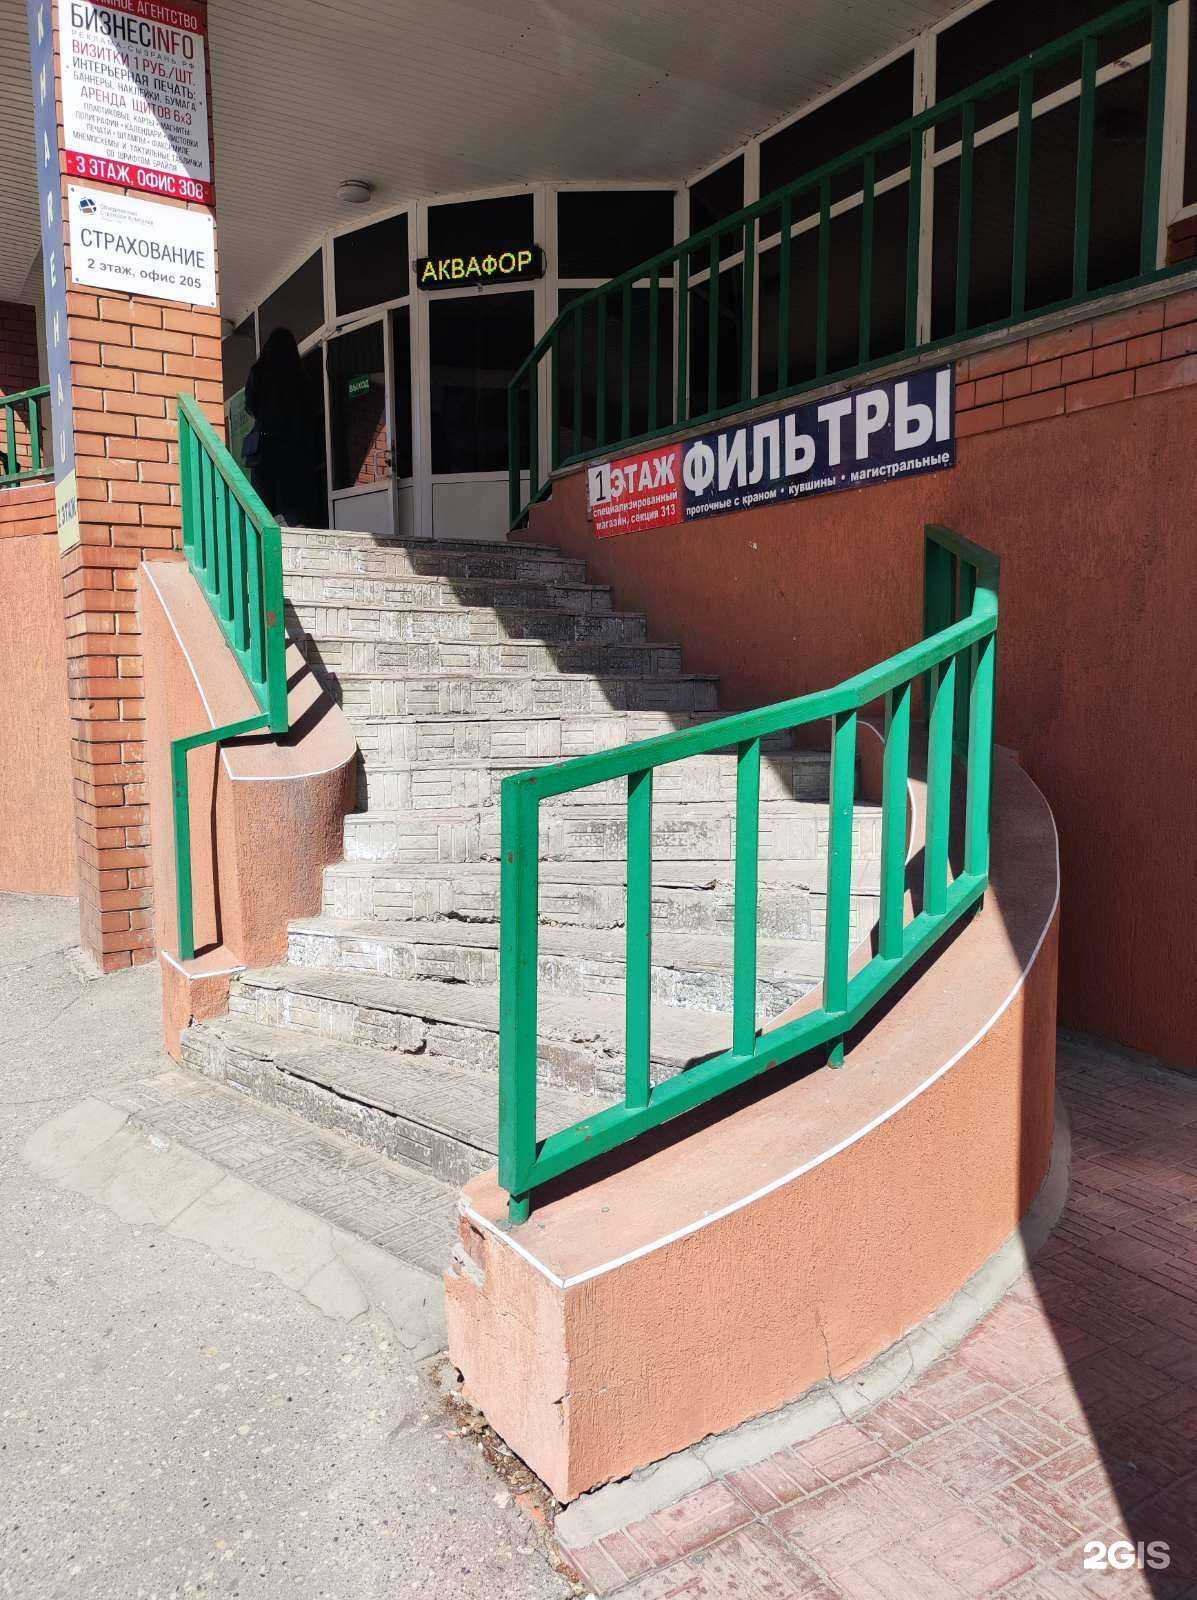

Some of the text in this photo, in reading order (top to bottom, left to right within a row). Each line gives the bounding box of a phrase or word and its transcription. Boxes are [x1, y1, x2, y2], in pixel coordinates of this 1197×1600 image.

[71, 4, 193, 59] БИЗНЕСINFO
[137, 1, 198, 30] АГЕНТСТВО
[72, 40, 129, 67] ВИЗИТКИ
[134, 58, 139, 72] 1
[73, 57, 148, 86] ИНТЕРЬЕРНАЯ
[81, 86, 127, 108] АРЕНДА
[132, 98, 171, 120] ЩИТОВ
[165, 95, 197, 111] БУМАГА
[133, 115, 156, 127] КАРТЫ
[76, 156, 86, 173] 3
[137, 171, 176, 194] ОФИС
[178, 178, 204, 199] 308
[81, 228, 205, 269] СТРАХОВАНИЕ
[87, 258, 95, 269] 2
[140, 269, 175, 285] офис
[179, 275, 202, 289] 205
[421, 250, 532, 282] АКВАФОР
[349, 379, 370, 393] ВЫХОД
[682, 369, 952, 498] ФИЛЬТРЫ
[594, 454, 675, 503] 1 ЭТАЖ
[686, 453, 951, 517] проточные с краном кувшины магистральные
[593, 490, 679, 519] специализированный
[631, 509, 660, 525] секция
[660, 503, 676, 518] 313
